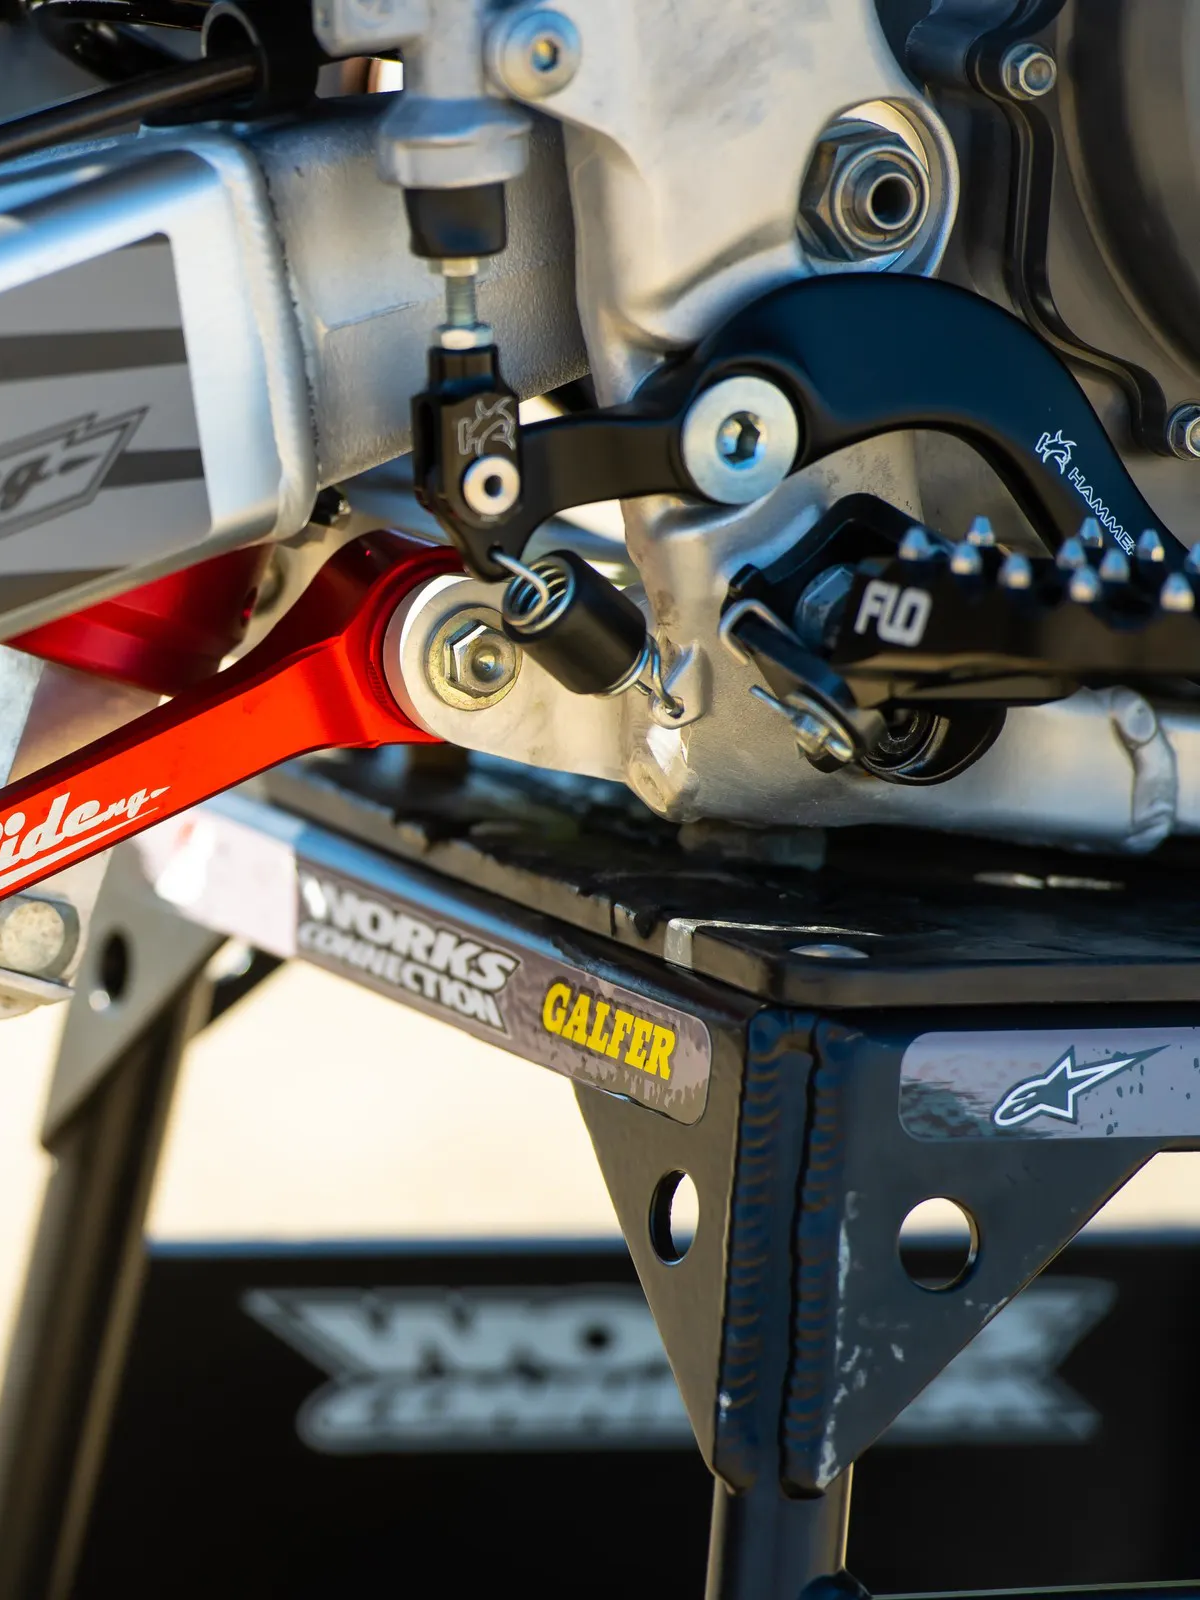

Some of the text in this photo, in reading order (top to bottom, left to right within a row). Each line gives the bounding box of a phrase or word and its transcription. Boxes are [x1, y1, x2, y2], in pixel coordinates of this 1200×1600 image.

[853, 579, 933, 648] FLO
[302, 876, 518, 990] WORKS
[542, 982, 676, 1081] GALFER
